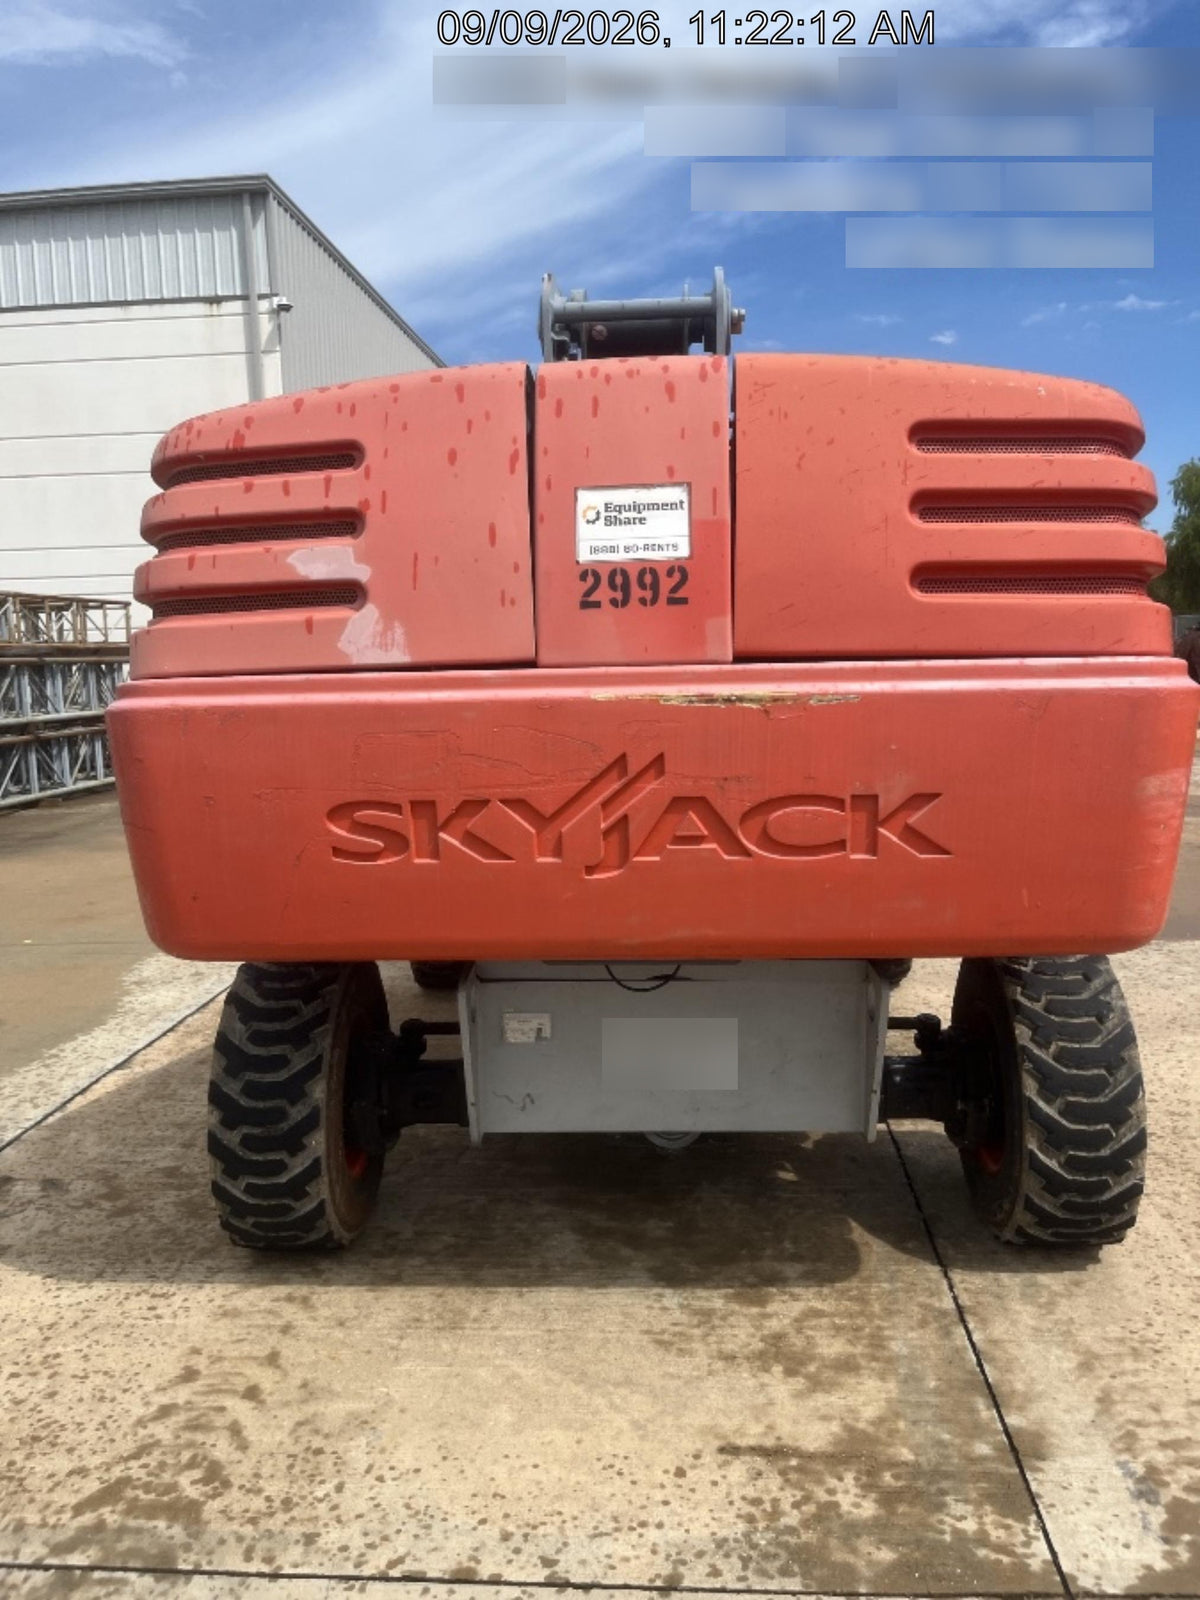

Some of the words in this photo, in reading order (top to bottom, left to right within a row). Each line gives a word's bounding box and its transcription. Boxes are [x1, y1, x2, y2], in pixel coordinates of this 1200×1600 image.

[603, 499, 685, 515] Equipment
[603, 515, 647, 527] Share
[579, 564, 689, 610] 2992
[325, 751, 954, 879] SKYJACK
